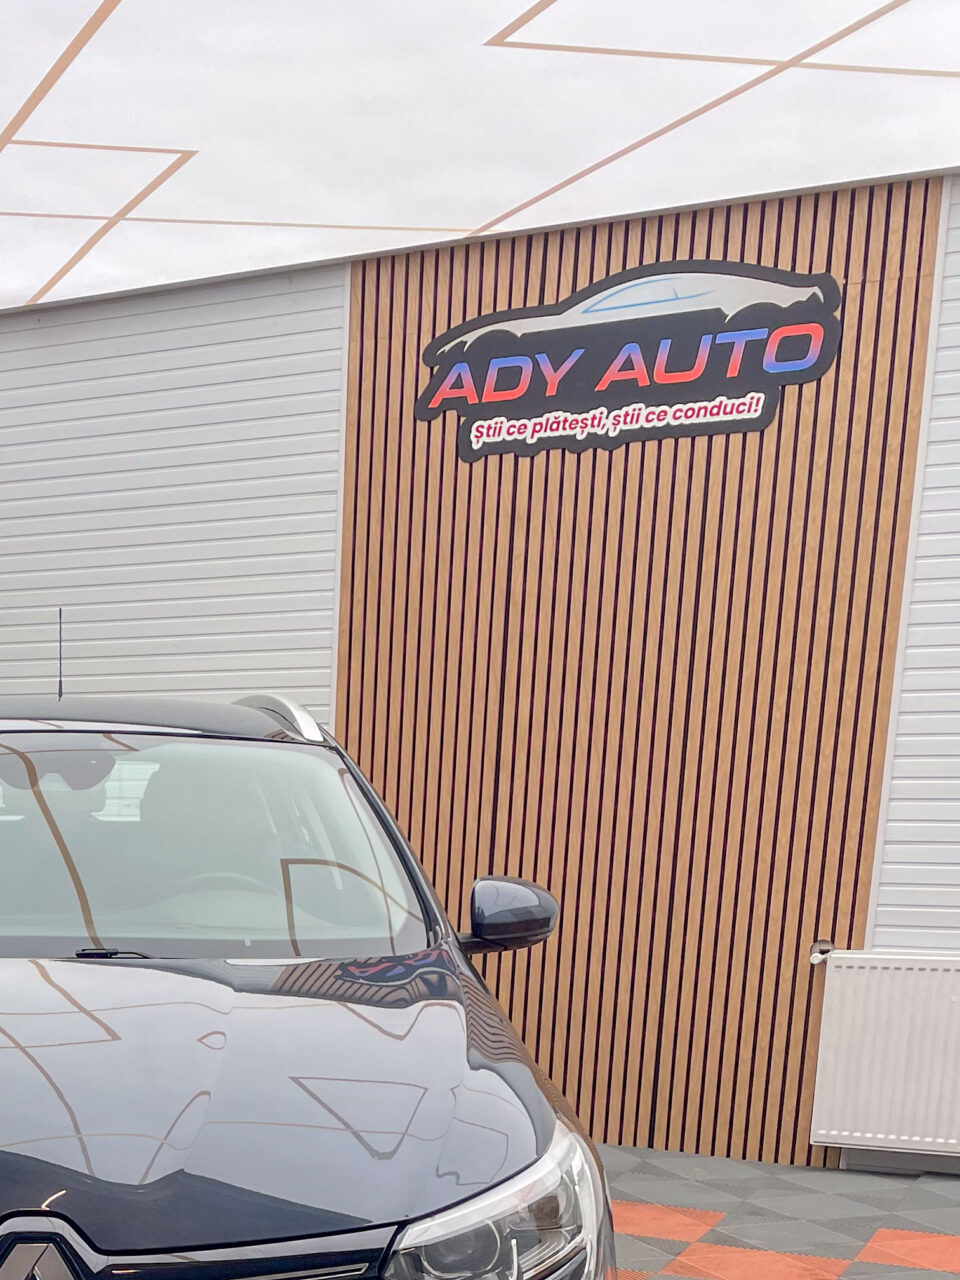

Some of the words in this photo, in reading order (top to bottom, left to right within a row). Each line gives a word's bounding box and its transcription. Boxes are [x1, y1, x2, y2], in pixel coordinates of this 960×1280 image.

[428, 348, 585, 408] ADY
[595, 322, 824, 392] AUTO
[474, 421, 503, 445] Știi
[506, 422, 528, 436] ce
[530, 411, 607, 439] plătești,
[611, 408, 642, 432] știi
[644, 409, 668, 423] ce
[672, 396, 761, 421] conduci!
